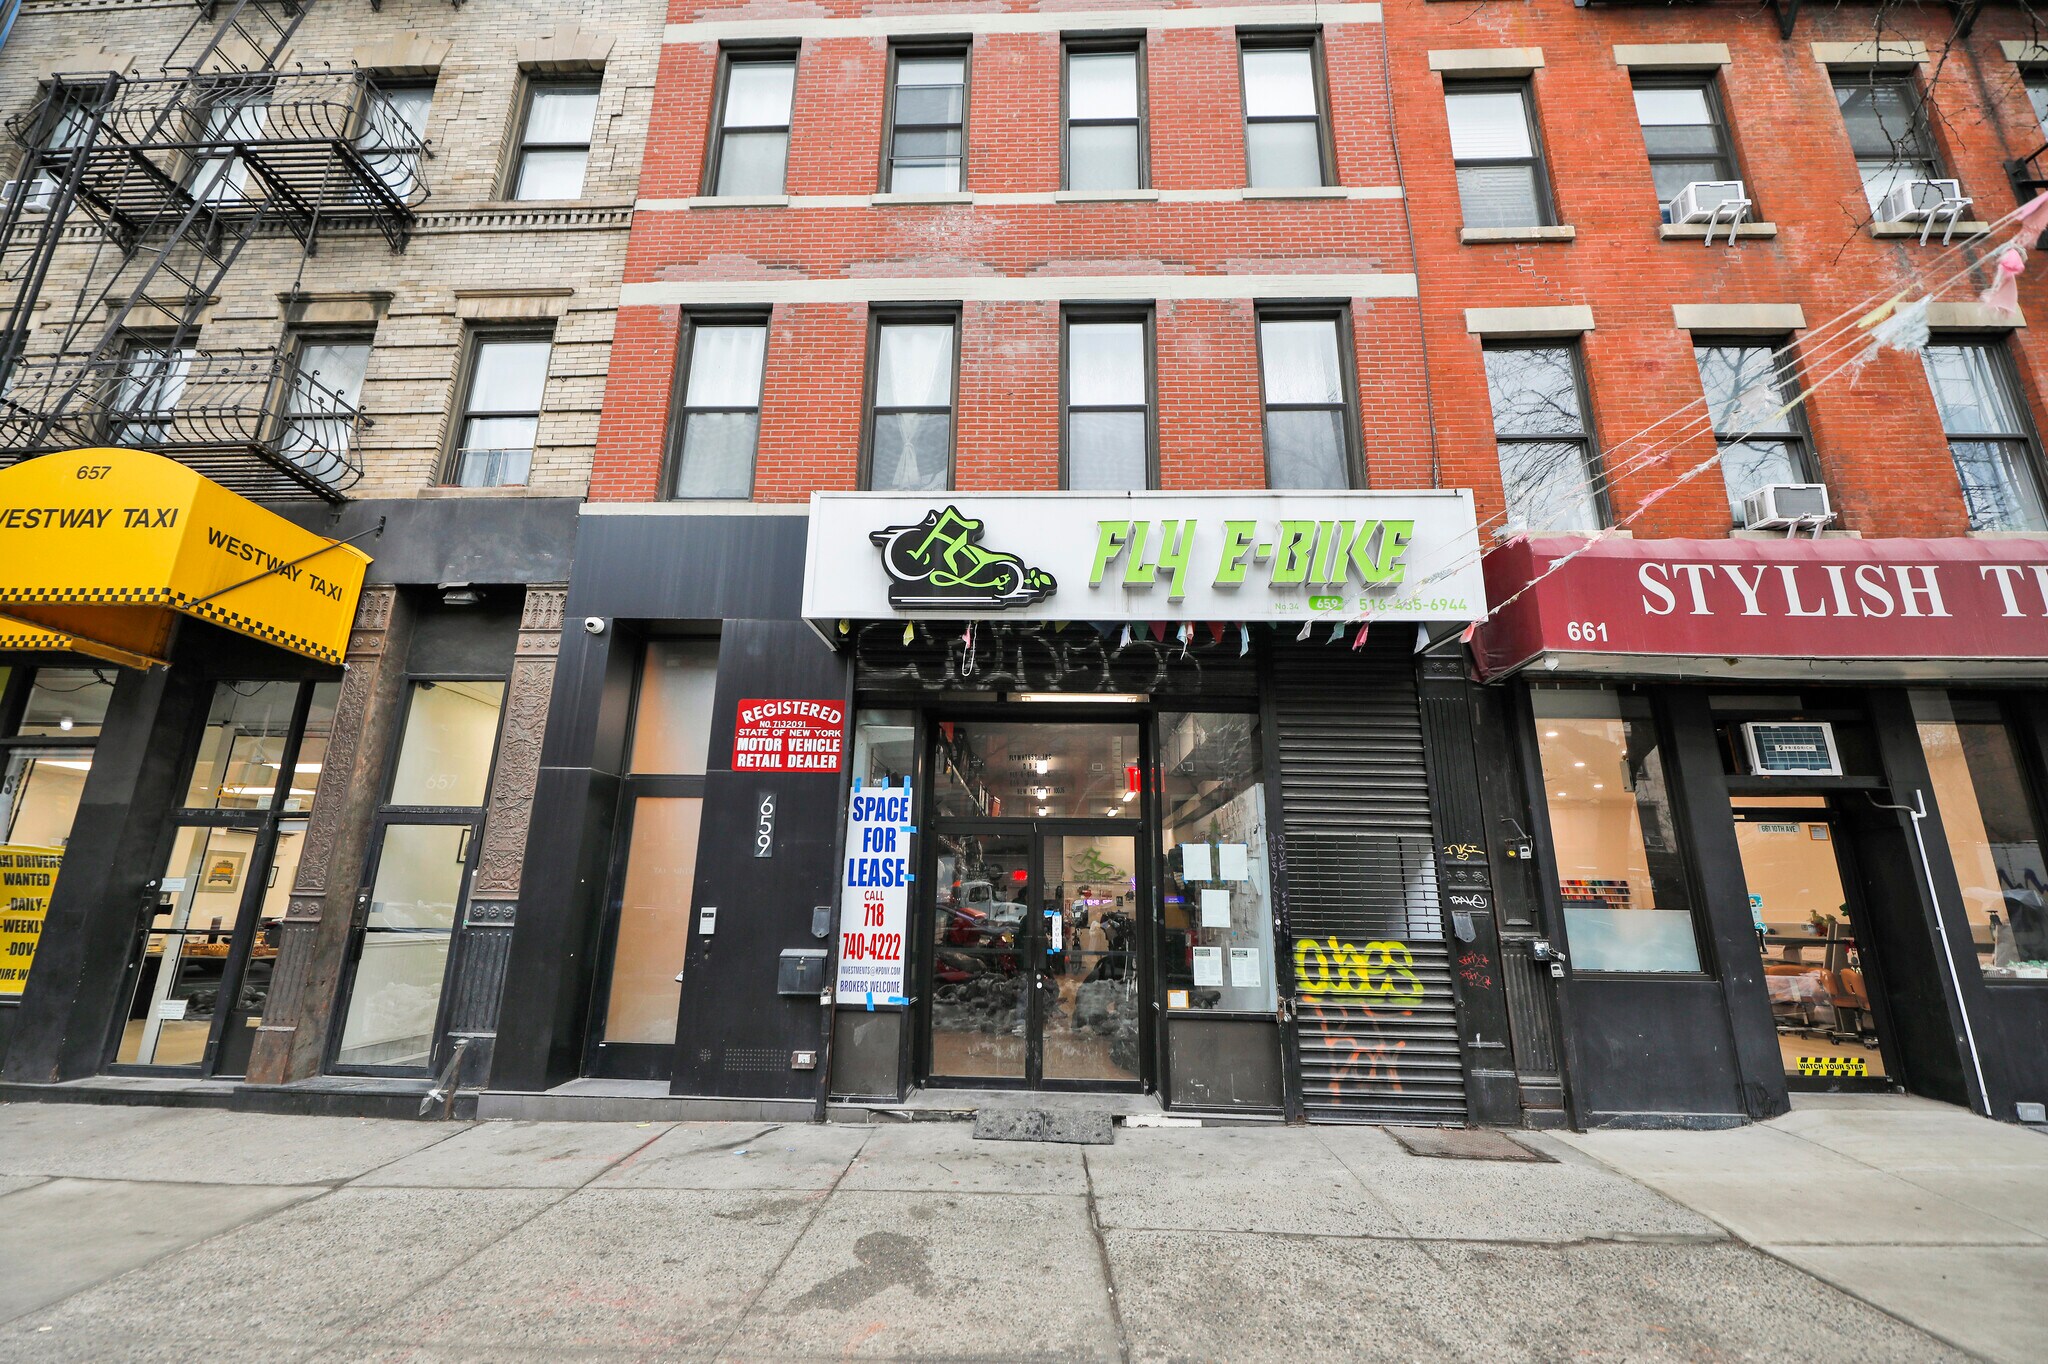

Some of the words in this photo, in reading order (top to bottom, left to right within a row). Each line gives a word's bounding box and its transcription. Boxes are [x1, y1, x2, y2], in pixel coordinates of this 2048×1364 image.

[76, 465, 112, 480] 657
[0, 508, 112, 529] ESTWAY
[123, 508, 179, 528] TAXI
[208, 527, 303, 582] WESTWAY
[309, 573, 343, 602] TAXI
[1088, 519, 1198, 602] FLY
[1211, 518, 1415, 589] E-BIKE
[1638, 562, 1953, 619] STYLISH
[1316, 598, 1339, 609] 659
[1566, 621, 1609, 643] 661
[742, 701, 842, 724] REGISTERED
[789, 729, 811, 737] NEW
[814, 729, 841, 737] YORK
[737, 738, 782, 752] MOTOR
[788, 739, 840, 753] VEHICLE
[737, 753, 782, 767] RETAIL
[787, 754, 837, 768] DEALER
[214, 783, 248, 798] 657
[425, 774, 458, 790] 657
[853, 796, 909, 822] SPACE
[758, 795, 774, 855] 659
[863, 827, 897, 853] FOR
[16, 854, 63, 870] DRIVERS
[3, 872, 50, 887] WANTED
[848, 858, 906, 887] LEASE
[864, 890, 885, 901] CALL
[864, 903, 885, 927] 718
[843, 933, 901, 960] 740-4222
[0, 968, 17, 980] IRE
[840, 980, 868, 993] BROKERS
[869, 981, 900, 993] WELCOME
